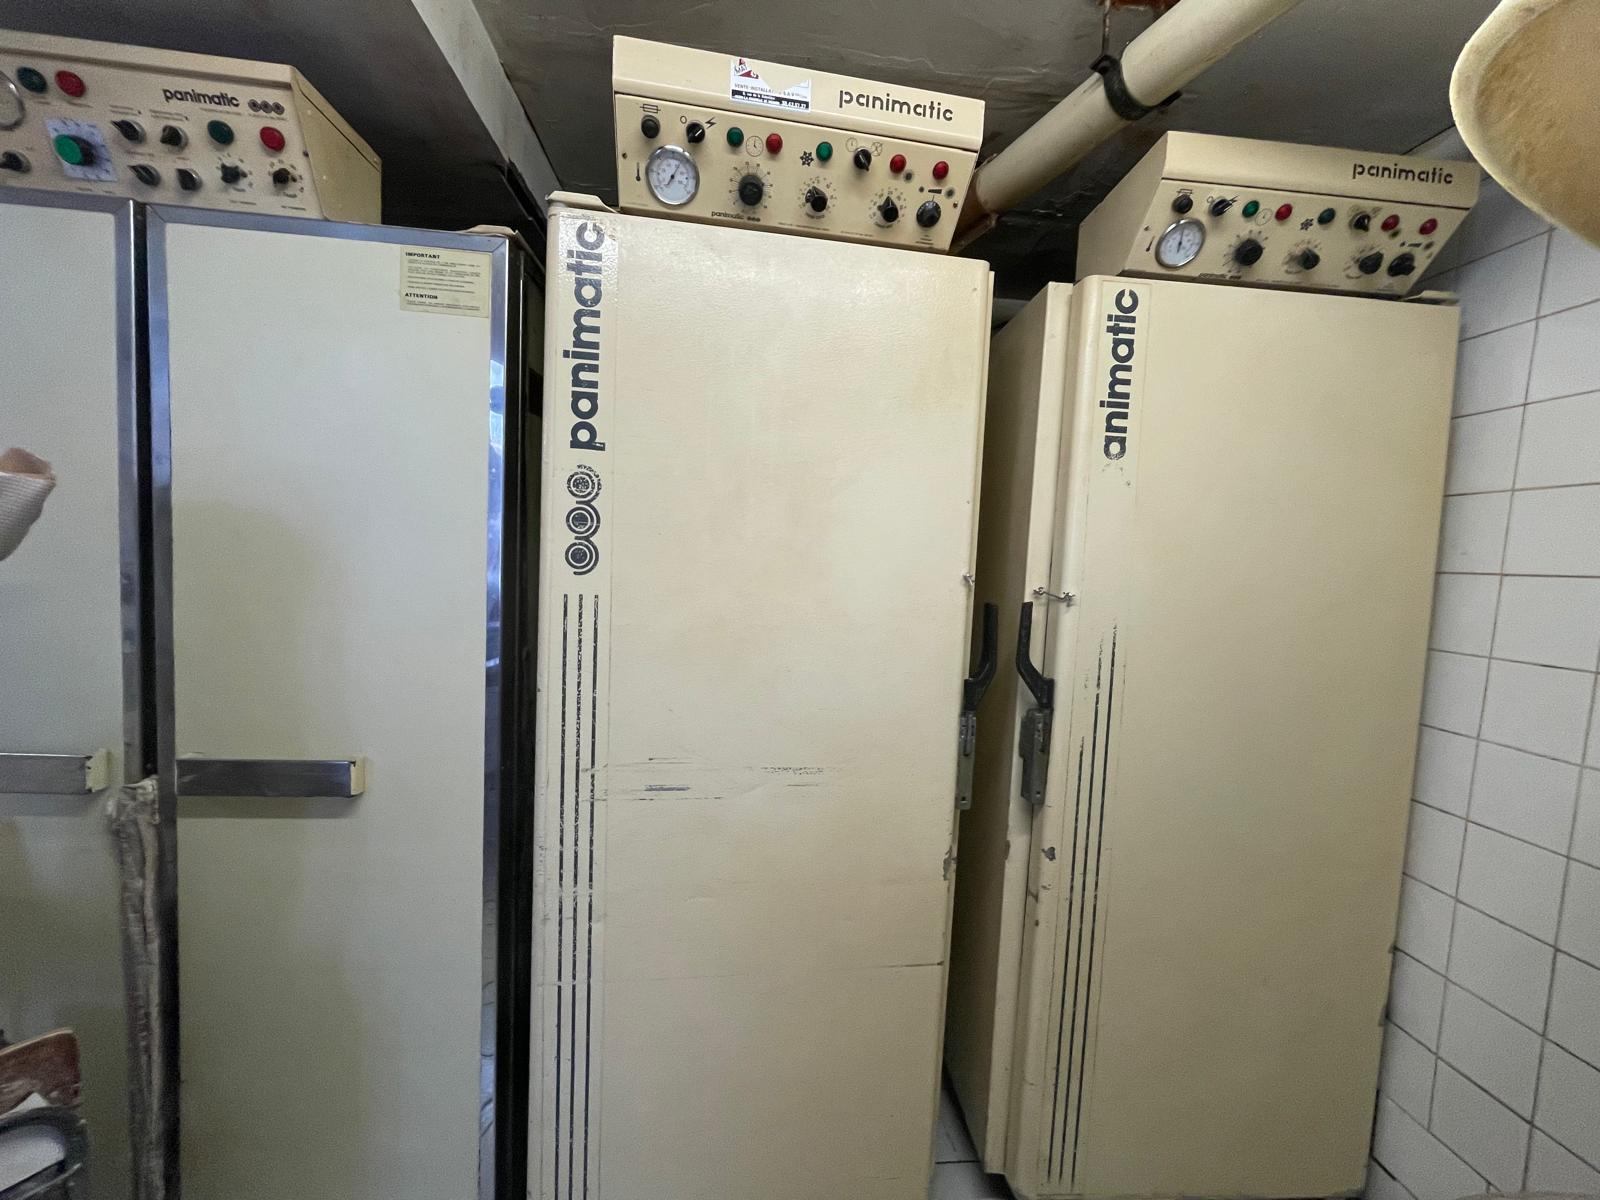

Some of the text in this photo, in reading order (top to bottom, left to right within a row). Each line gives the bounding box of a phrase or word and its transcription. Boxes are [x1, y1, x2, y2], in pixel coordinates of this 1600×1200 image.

[162, 88, 240, 108] panimatic
[839, 90, 953, 122] panimatic
[1352, 163, 1453, 185] panimatic
[563, 221, 605, 451] panimatic
